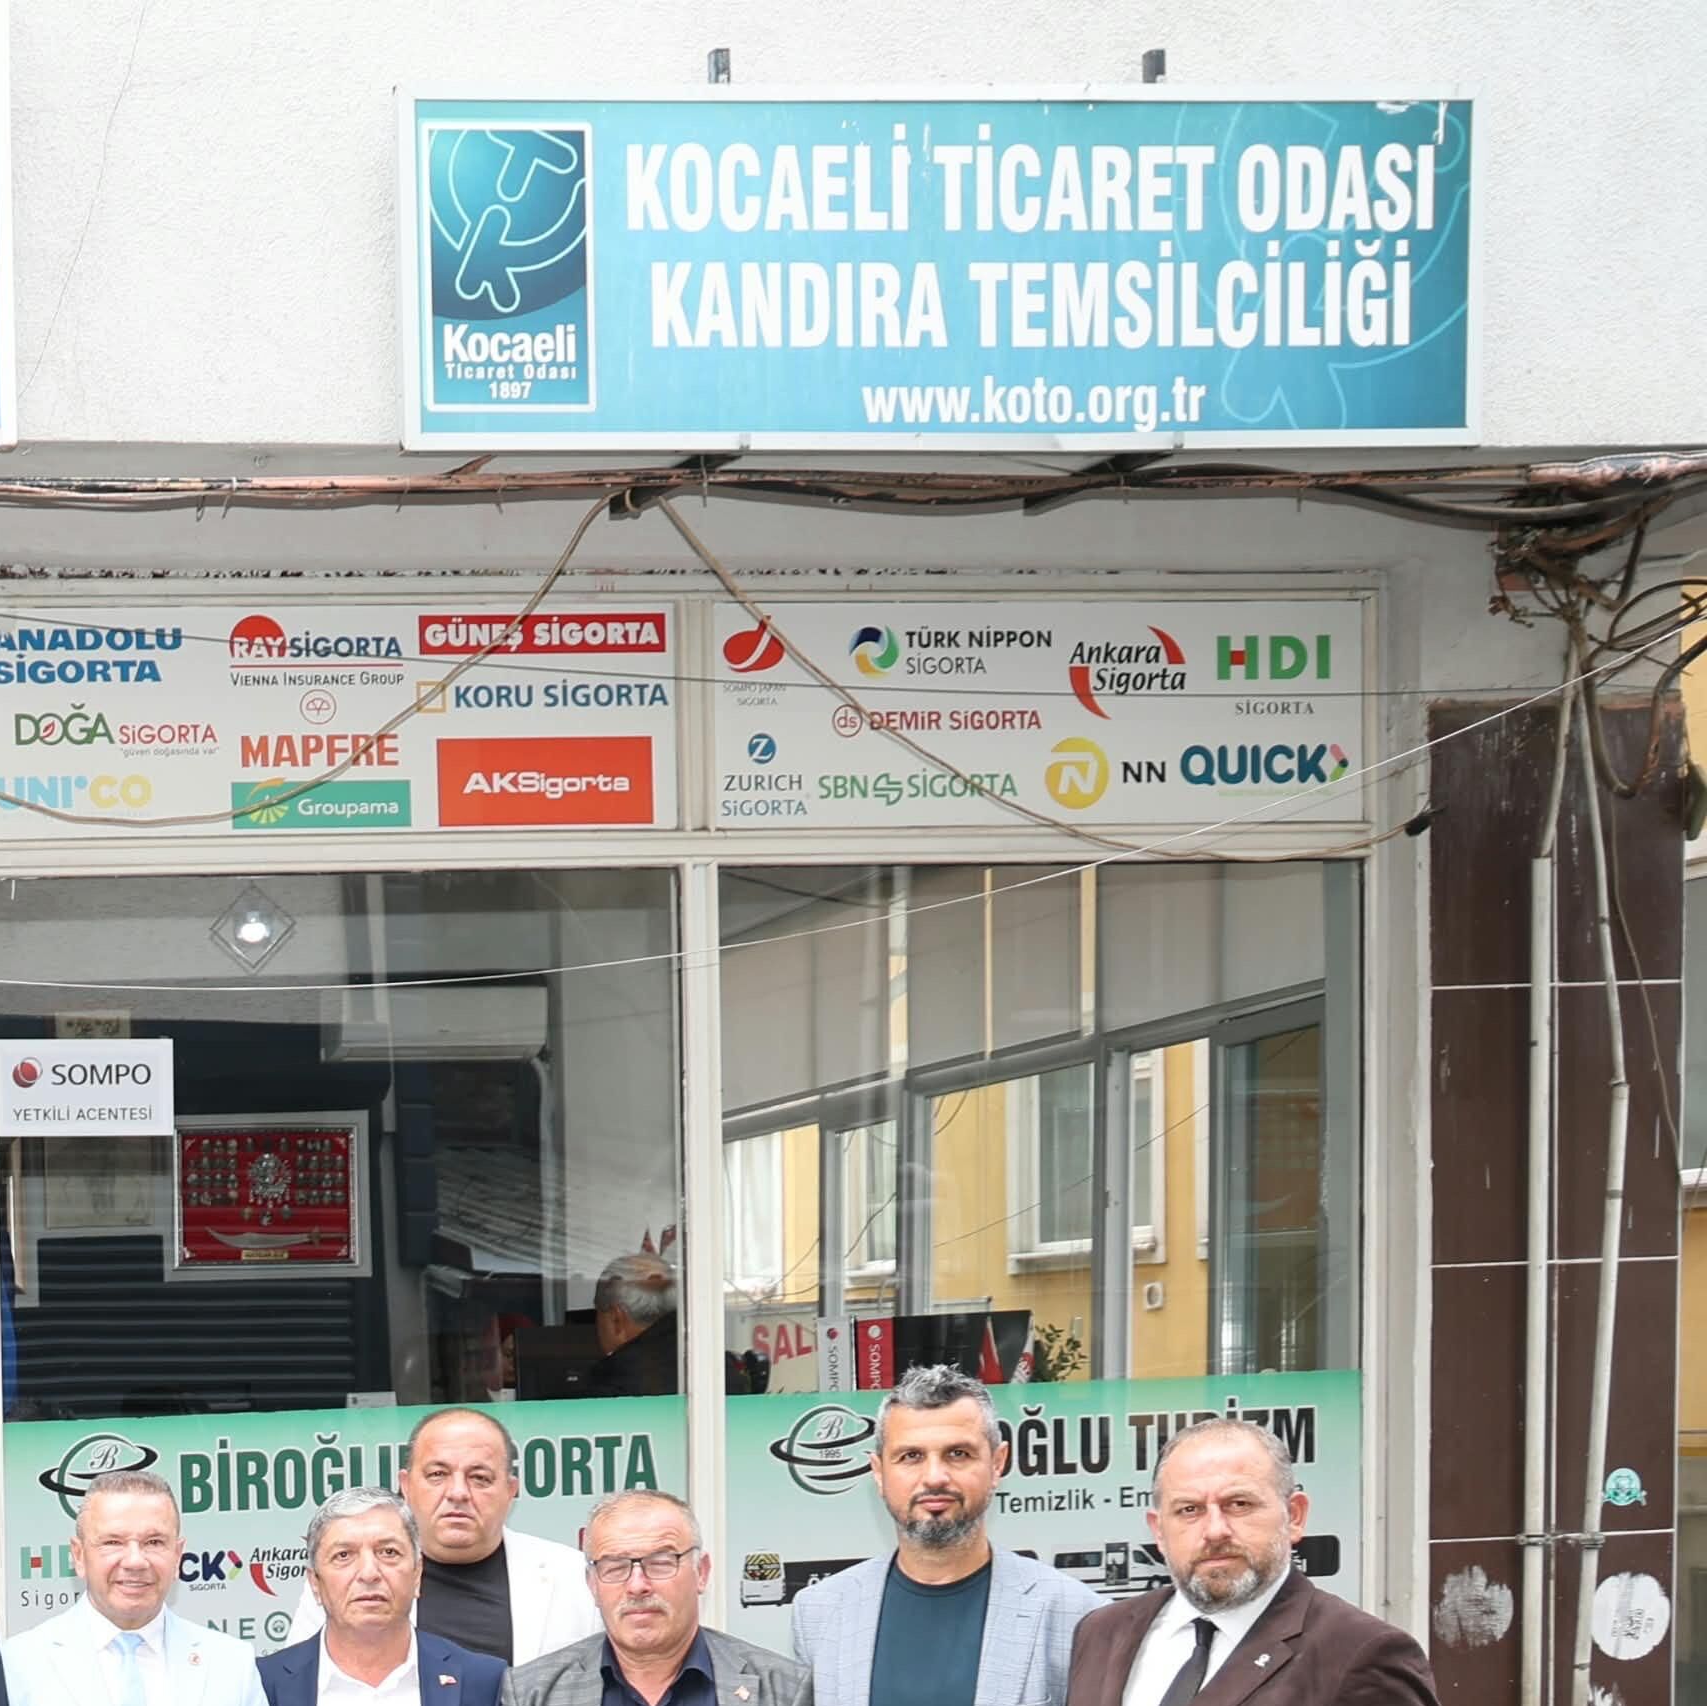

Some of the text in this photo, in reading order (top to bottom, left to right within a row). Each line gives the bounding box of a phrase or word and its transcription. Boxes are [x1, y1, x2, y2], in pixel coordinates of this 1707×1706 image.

[626, 123, 1434, 233] KOCAELİ TİCARET ODASI
[651, 238, 1411, 350] KANDIRA TEMSİLCİLİĞİ
[444, 323, 577, 363] Kocaeli
[489, 382, 532, 399] 1897
[862, 375, 1206, 433] www.koto.org.tr
[532, 613, 660, 647] SİGORTA
[905, 625, 1052, 650] TÜRK NİPPON
[232, 631, 402, 658] RAY SİGORTA
[1217, 635, 1330, 681] HDI
[906, 650, 986, 676] SİGORTA
[1069, 641, 1187, 695] Ankara Sigorta
[455, 677, 668, 710] KORU SİGORTA
[1235, 698, 1314, 716] SİGORTA
[14, 703, 114, 745] DOĞA
[240, 733, 399, 768] MAPFRE
[1122, 761, 1166, 784] NN
[1180, 744, 1327, 785] QUICK
[462, 772, 630, 800] AKSigorta
[723, 774, 802, 792] ZURICH
[819, 769, 1018, 799] SBN SİGORTA
[298, 799, 399, 818] Groupama
[51, 1063, 151, 1085] SOMPO
[12, 1106, 152, 1121] YETKİLİ ACENTESİ
[819, 1449, 842, 1459] 1995
[996, 1487, 1095, 1514] Temizlik
[266, 1564, 308, 1580] Sigor
[21, 1590, 79, 1610] Sigor
